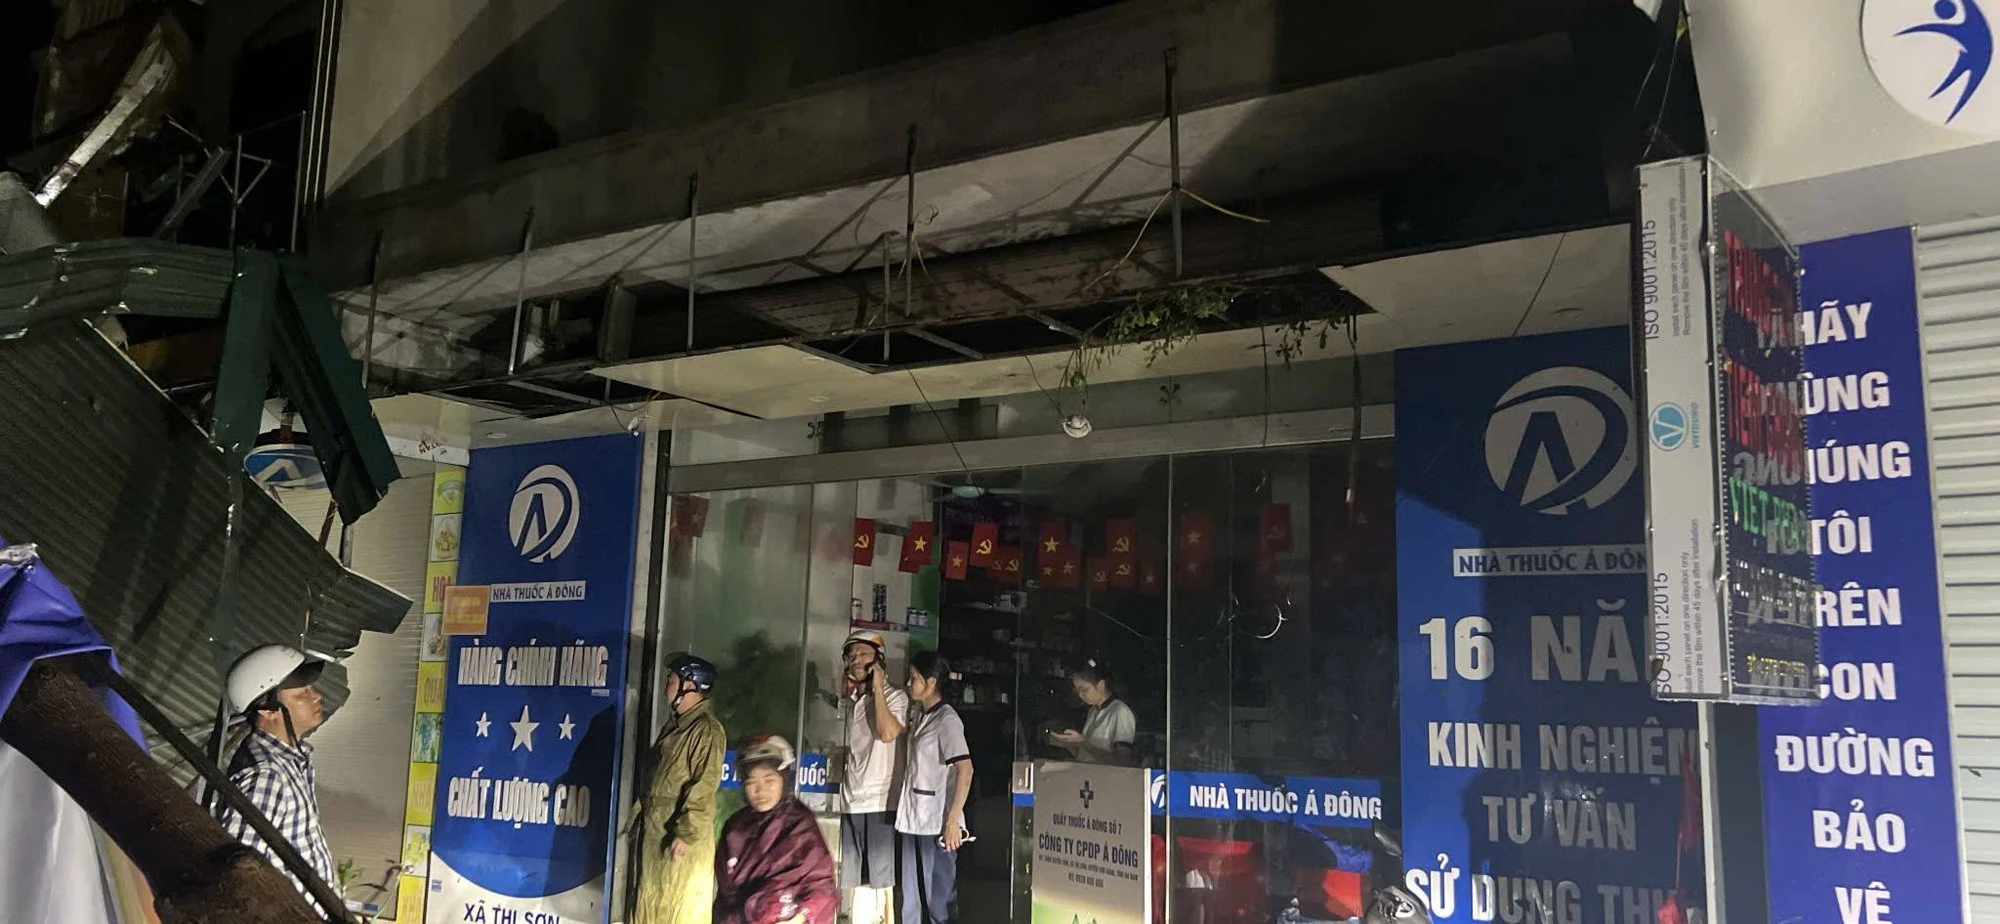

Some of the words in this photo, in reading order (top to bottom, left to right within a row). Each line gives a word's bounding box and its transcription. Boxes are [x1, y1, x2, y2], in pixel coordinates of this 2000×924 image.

[1642, 220, 1658, 304] 9001:2015
[1644, 310, 1659, 340] ISO
[1803, 371, 1891, 415] ÙNG
[1811, 509, 1872, 555] TÔI
[1459, 551, 1501, 573] NHÀ
[1507, 547, 1577, 572] THUỐC
[1584, 549, 1599, 571] Á
[1604, 547, 1647, 570] ĐÔN
[1681, 552, 1689, 568] only
[1692, 562, 1700, 579] after
[492, 585, 512, 600] NHÀ
[514, 582, 544, 599] THUỐC
[546, 583, 554, 599] Á
[555, 583, 583, 598] ĐÔNG
[1682, 569, 1690, 603] direction
[1693, 581, 1702, 599] days
[1815, 581, 1902, 627] RÊN
[1693, 601, 1701, 611] 45
[1419, 615, 1495, 681] 16
[1530, 598, 1650, 683] NĂ
[1683, 633, 1692, 655] panel
[1685, 621, 1691, 632] on
[458, 638, 503, 685] HÀNG
[505, 638, 557, 686] CHÍNH
[559, 638, 608, 687] HÃNG
[1695, 653, 1703, 666] the
[1656, 669, 1671, 693] SO
[1428, 722, 1522, 770] KINH
[1774, 727, 1935, 777] ĐƯỜNG
[800, 762, 826, 786] UỐC
[448, 766, 491, 819] CHẤT
[492, 776, 550, 829] LƯỢNG
[553, 783, 590, 828] CAO
[1189, 782, 1229, 809] NHÀ
[1234, 783, 1298, 814] THUỐC
[1304, 788, 1319, 816] Á
[1325, 793, 1382, 820] ĐÔNG
[1482, 791, 1537, 845] TƯ
[1812, 798, 1907, 853] BẢO
[1039, 830, 1062, 852] CÔNG
[1064, 838, 1074, 855] TY
[1076, 839, 1100, 860] CPDP
[1103, 842, 1109, 862] Á
[1112, 843, 1138, 868] ĐÔNG
[1405, 853, 1460, 918] SỬ
[464, 899, 486, 924] XÃ
